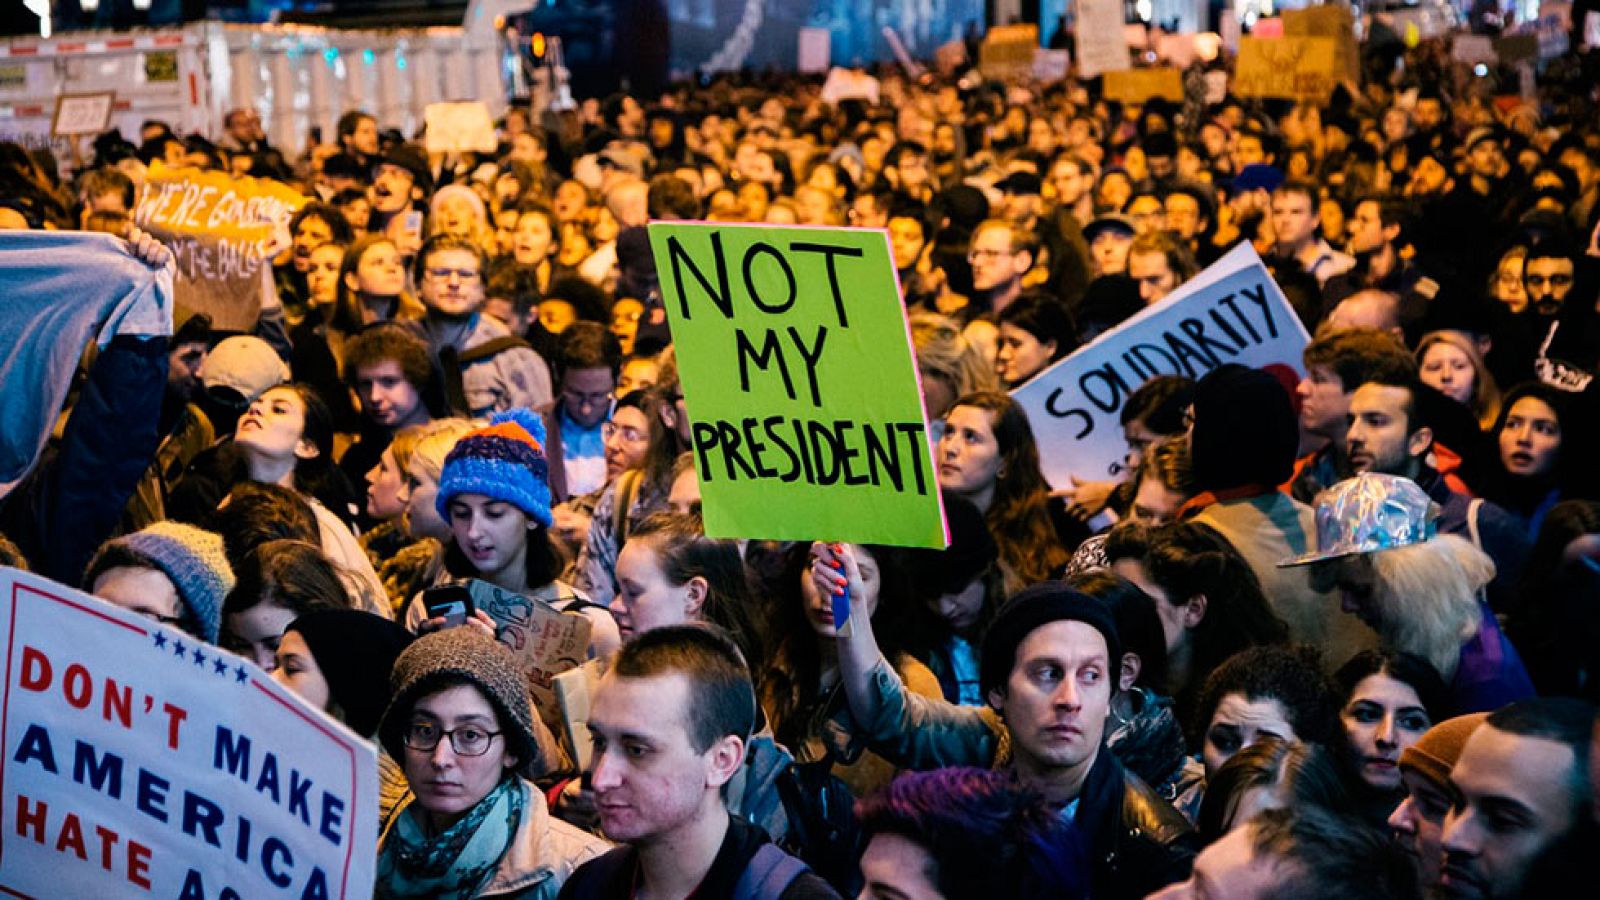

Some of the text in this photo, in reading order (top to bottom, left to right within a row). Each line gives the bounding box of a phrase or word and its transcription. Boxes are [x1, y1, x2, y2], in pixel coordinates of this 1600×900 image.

[136, 179, 217, 227] WE'RE
[667, 231, 862, 328] NOT
[735, 325, 828, 408] MY
[692, 415, 928, 496] PRESIDENT
[19, 645, 345, 846] DON'T MAKE
[14, 723, 329, 900] AMERICA
[15, 794, 153, 891] HATE
